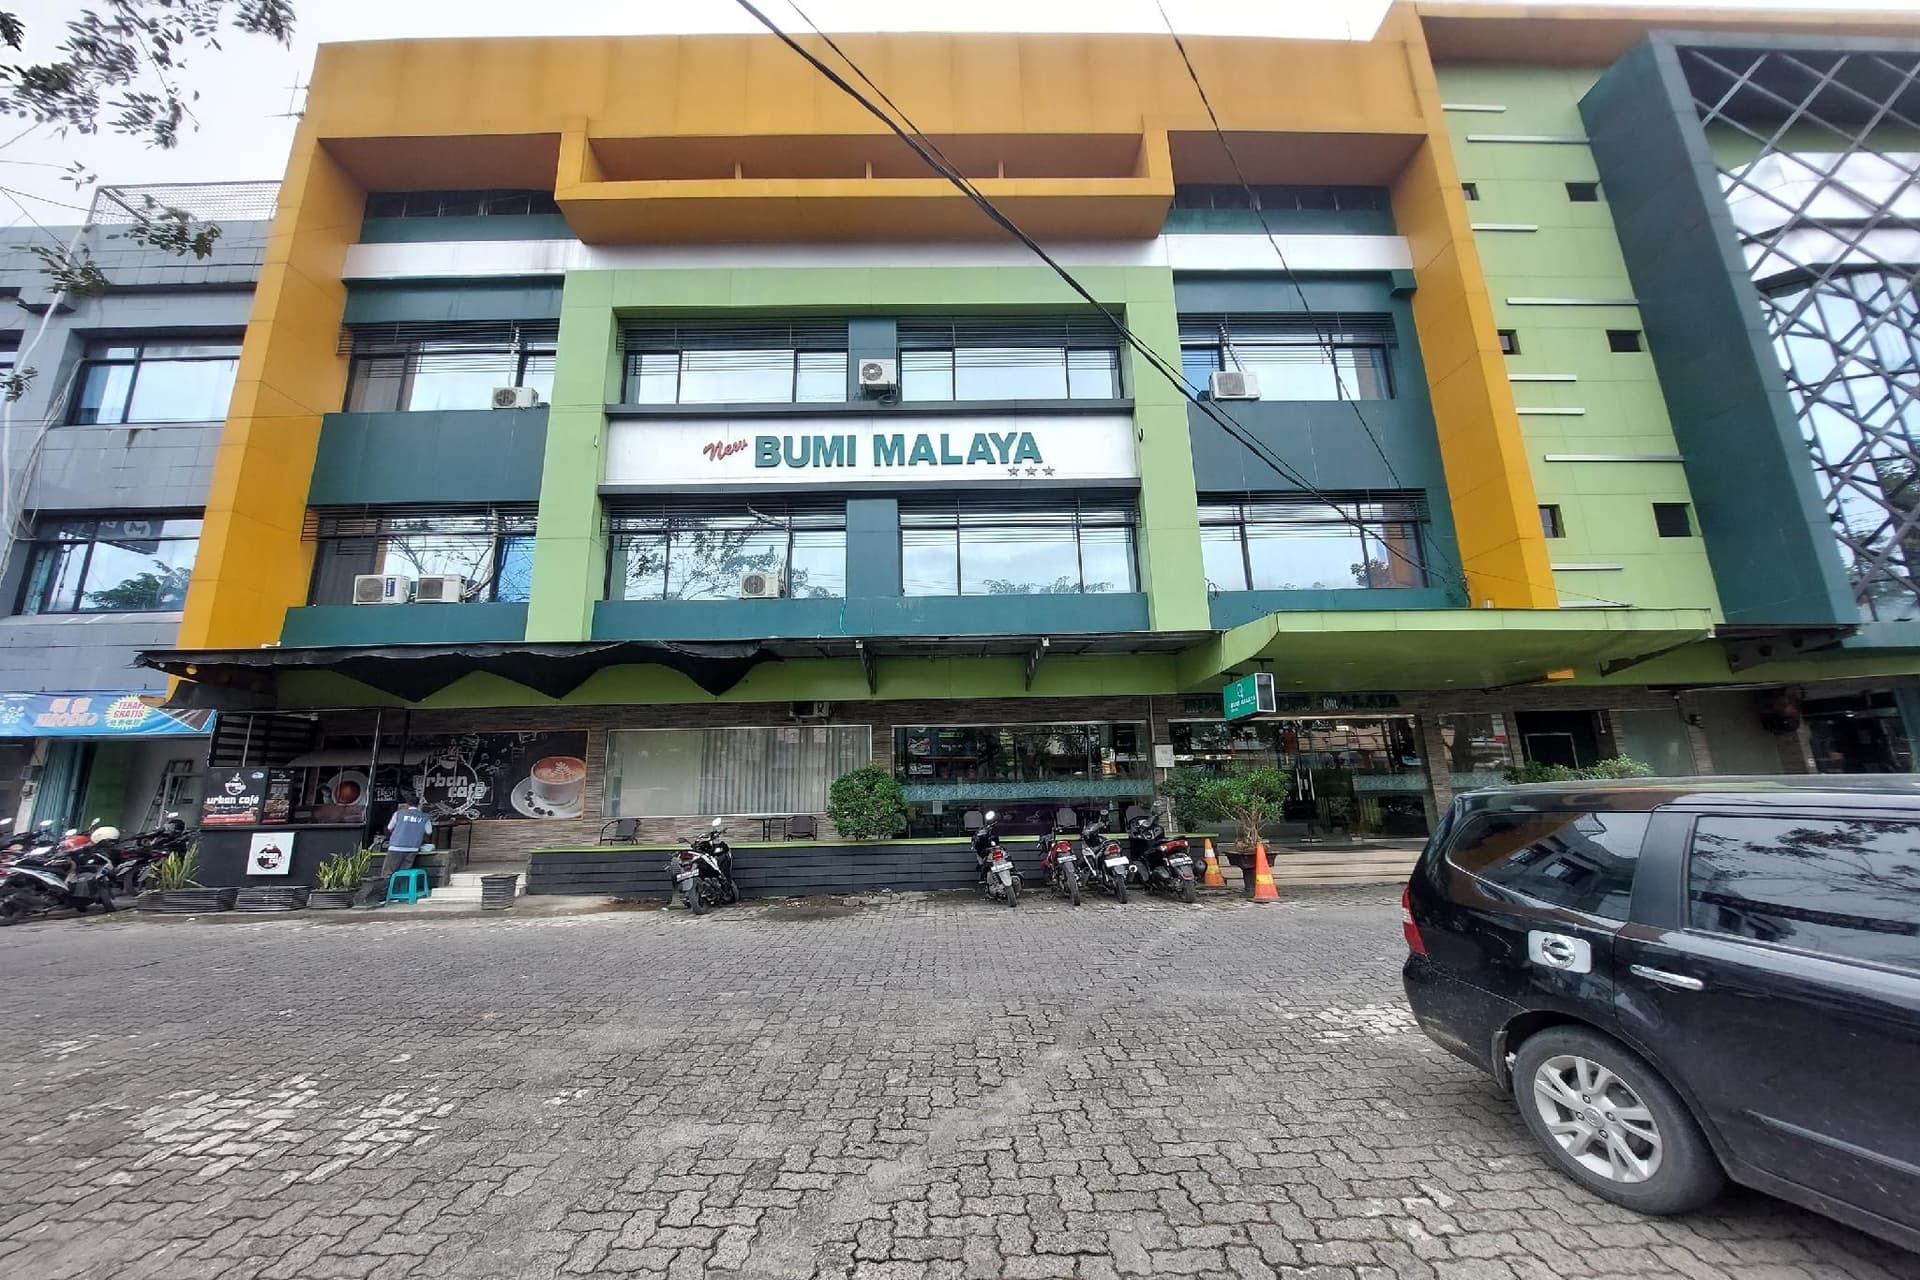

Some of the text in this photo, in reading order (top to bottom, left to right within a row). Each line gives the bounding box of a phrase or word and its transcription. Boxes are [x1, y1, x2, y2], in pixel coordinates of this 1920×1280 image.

[703, 432, 1043, 468] New BUMI MALAYA
[113, 710, 144, 718] GRATIS
[206, 795, 236, 804] urban
